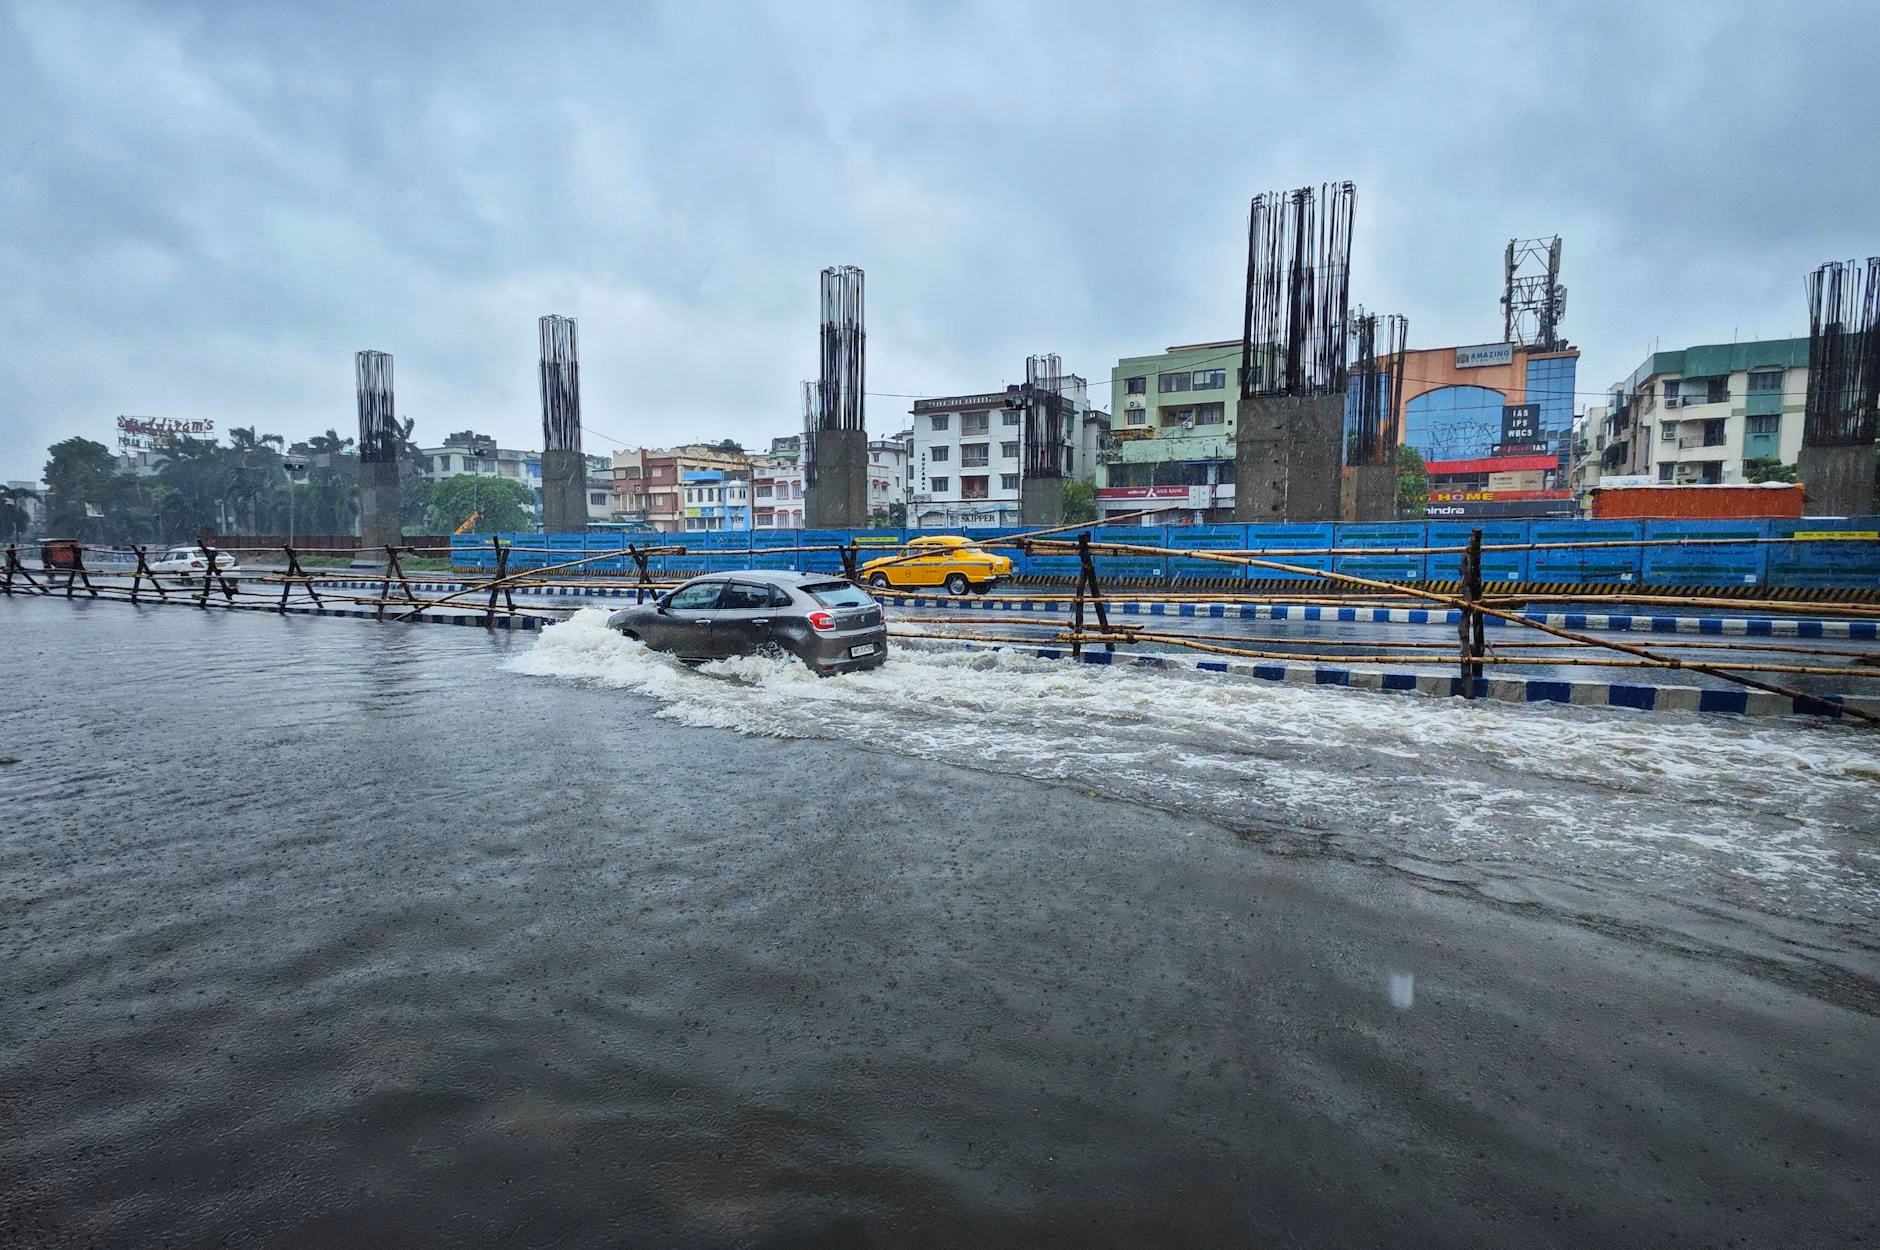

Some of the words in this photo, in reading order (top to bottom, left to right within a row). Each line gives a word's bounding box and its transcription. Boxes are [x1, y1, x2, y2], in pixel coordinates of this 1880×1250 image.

[1470, 350, 1510, 360] AMAZING
[1512, 409, 1529, 418] IAS
[1512, 419, 1528, 428] IPS
[1507, 429, 1533, 438] WBCS
[1532, 443, 1547, 452] IAS
[1438, 492, 1495, 501] HOME
[960, 512, 995, 523] SKIPPER
